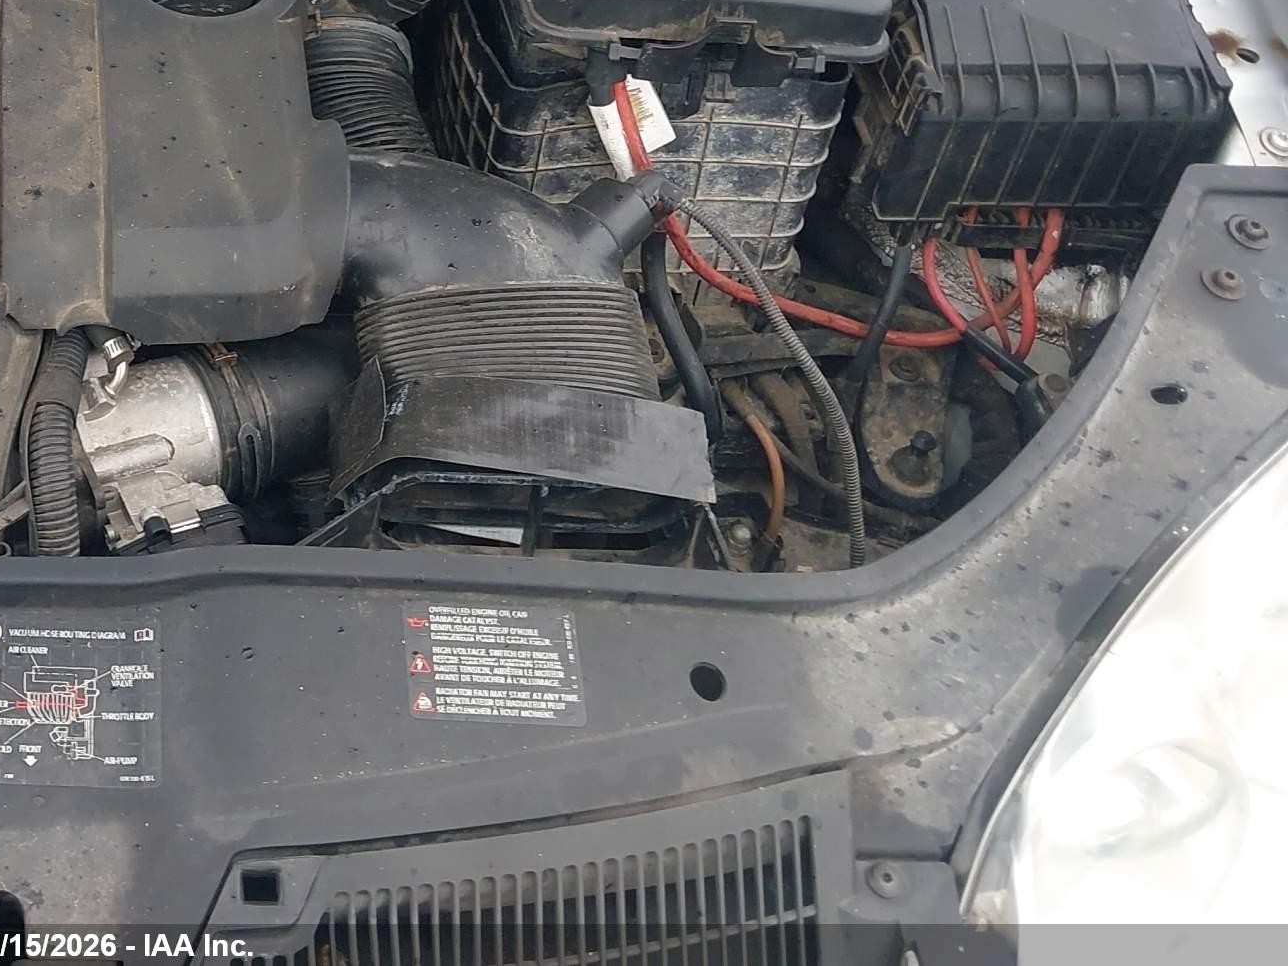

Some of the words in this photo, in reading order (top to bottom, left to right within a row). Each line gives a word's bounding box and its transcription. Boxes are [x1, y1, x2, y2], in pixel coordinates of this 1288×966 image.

[471, 608, 498, 616] ENGINE
[429, 615, 462, 623] DAMAGE
[8, 628, 39, 637] VACUUM
[58, 630, 91, 639] ROUTING
[91, 631, 126, 640] DIAGRAM
[496, 635, 506, 643] LE
[8, 646, 19, 654] AIR
[20, 646, 49, 655] CLEANER
[432, 646, 452, 654] HIGH
[518, 650, 532, 659] OFF
[532, 651, 560, 660] ENGINE
[111, 672, 154, 680] VENTILATION
[434, 673, 460, 682] AVANT
[460, 674, 472, 682] DE
[435, 687, 472, 696] RADIATOR
[473, 689, 489, 697] FAN
[490, 690, 507, 698] MAY
[508, 691, 531, 699] START
[532, 692, 542, 700] AT
[542, 693, 560, 701] ANY
[436, 696, 446, 704] LE
[494, 699, 505, 707] DE
[547, 702, 566, 710] PEUT
[437, 705, 446, 713] SE
[500, 708, 519, 716] TOUT
[101, 712, 134, 720] THROTTLE
[134, 713, 154, 721] BODY
[19, 745, 42, 753] FRONT
